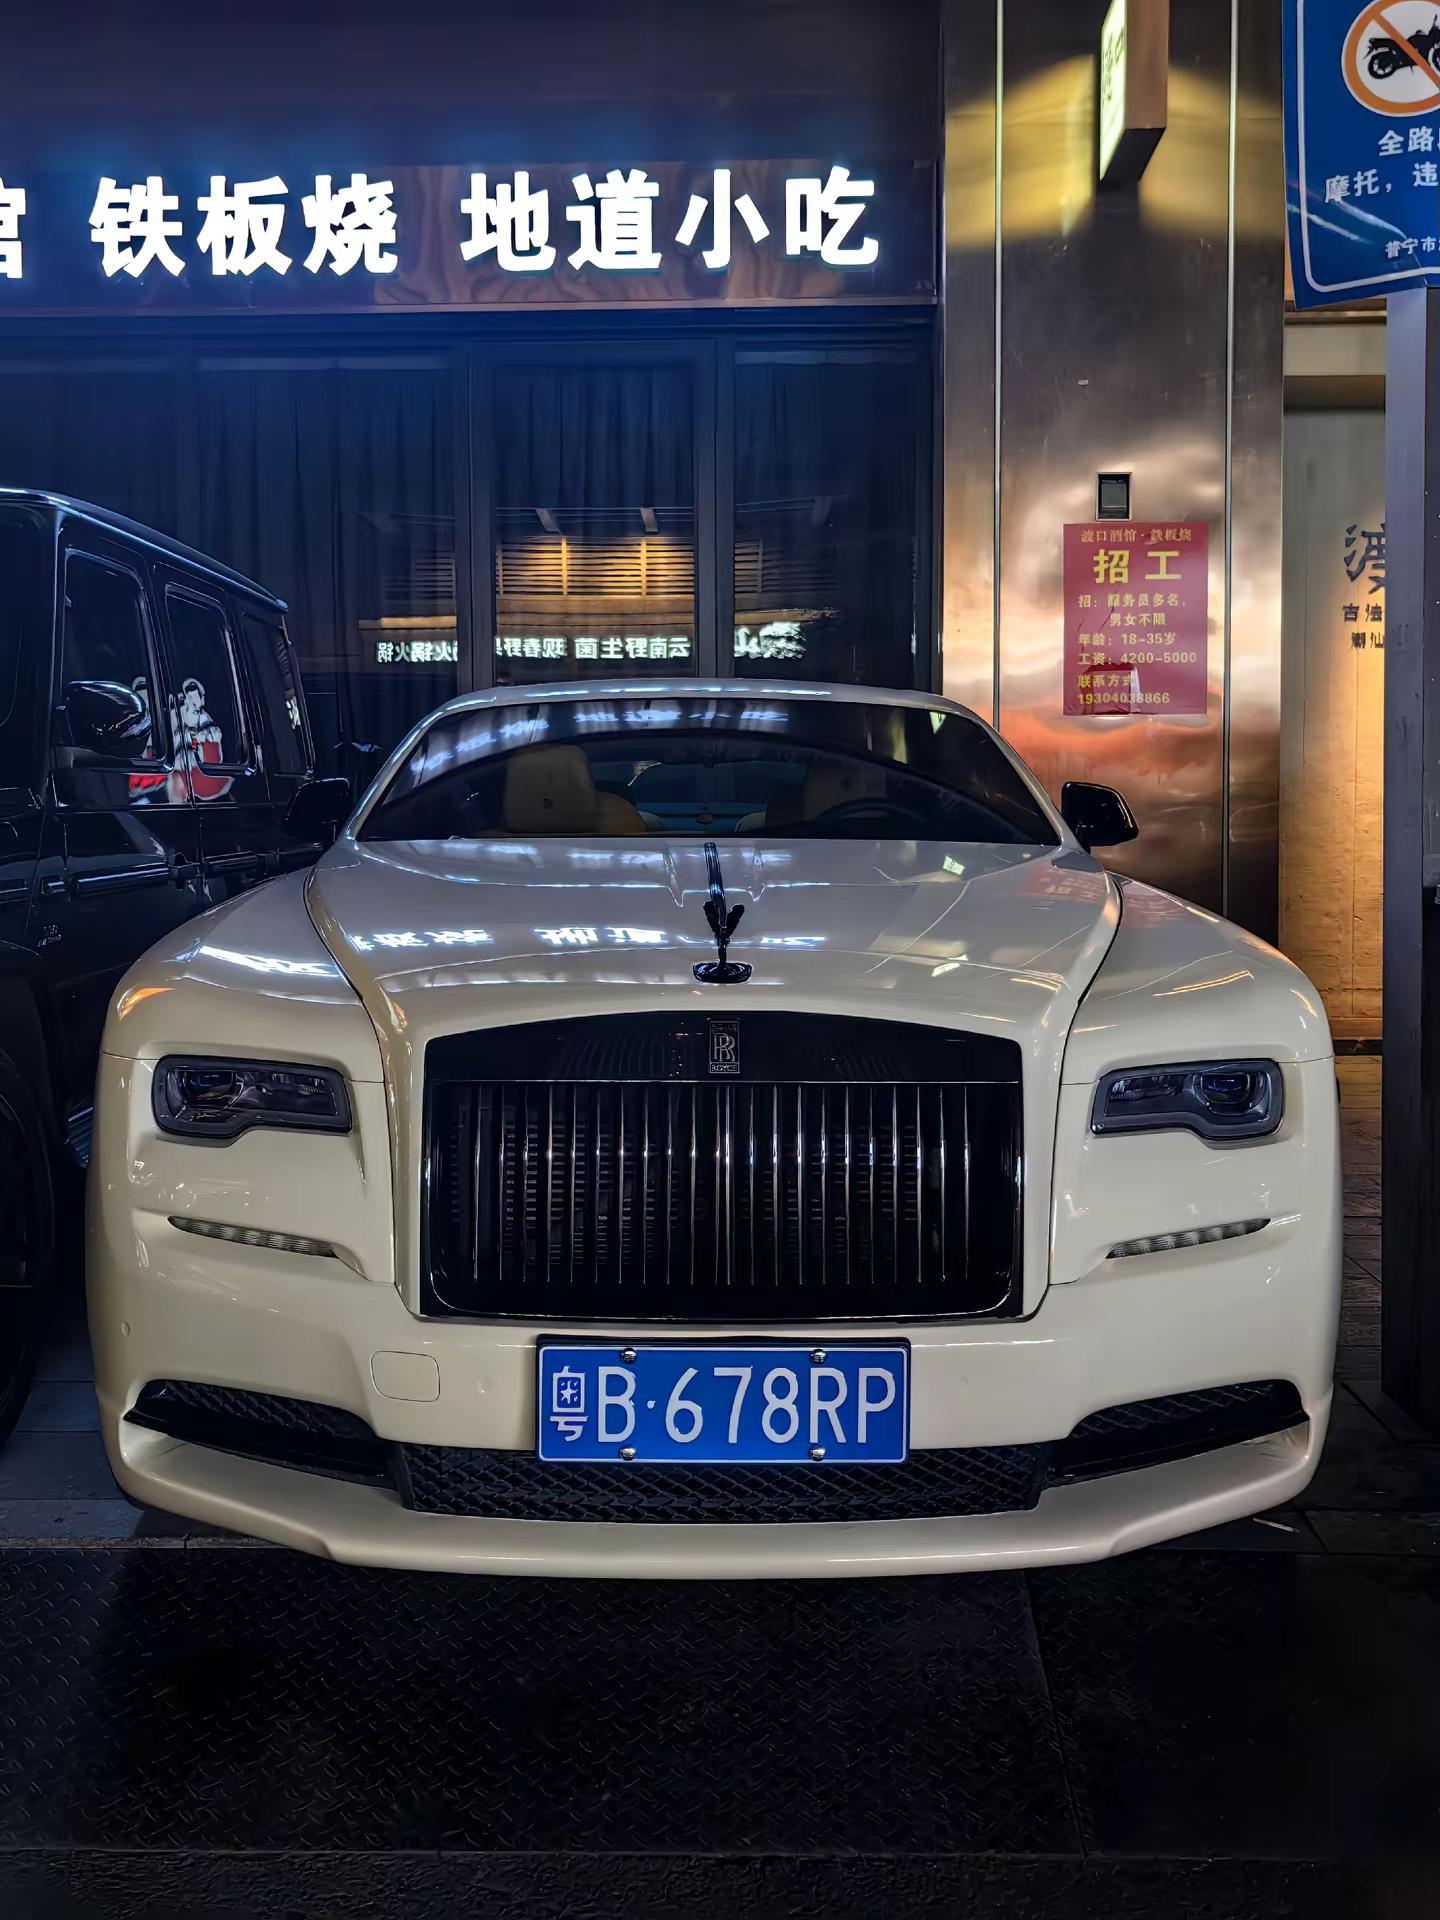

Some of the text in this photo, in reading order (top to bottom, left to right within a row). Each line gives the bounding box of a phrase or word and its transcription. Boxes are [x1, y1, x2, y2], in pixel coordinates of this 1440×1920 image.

[1377, 125, 1440, 157] 全路
[88, 171, 399, 279] 铁板烧
[459, 164, 880, 275] 地道小吃
[1384, 235, 1440, 260] 普宁市
[1109, 613, 1166, 627] 男女不限
